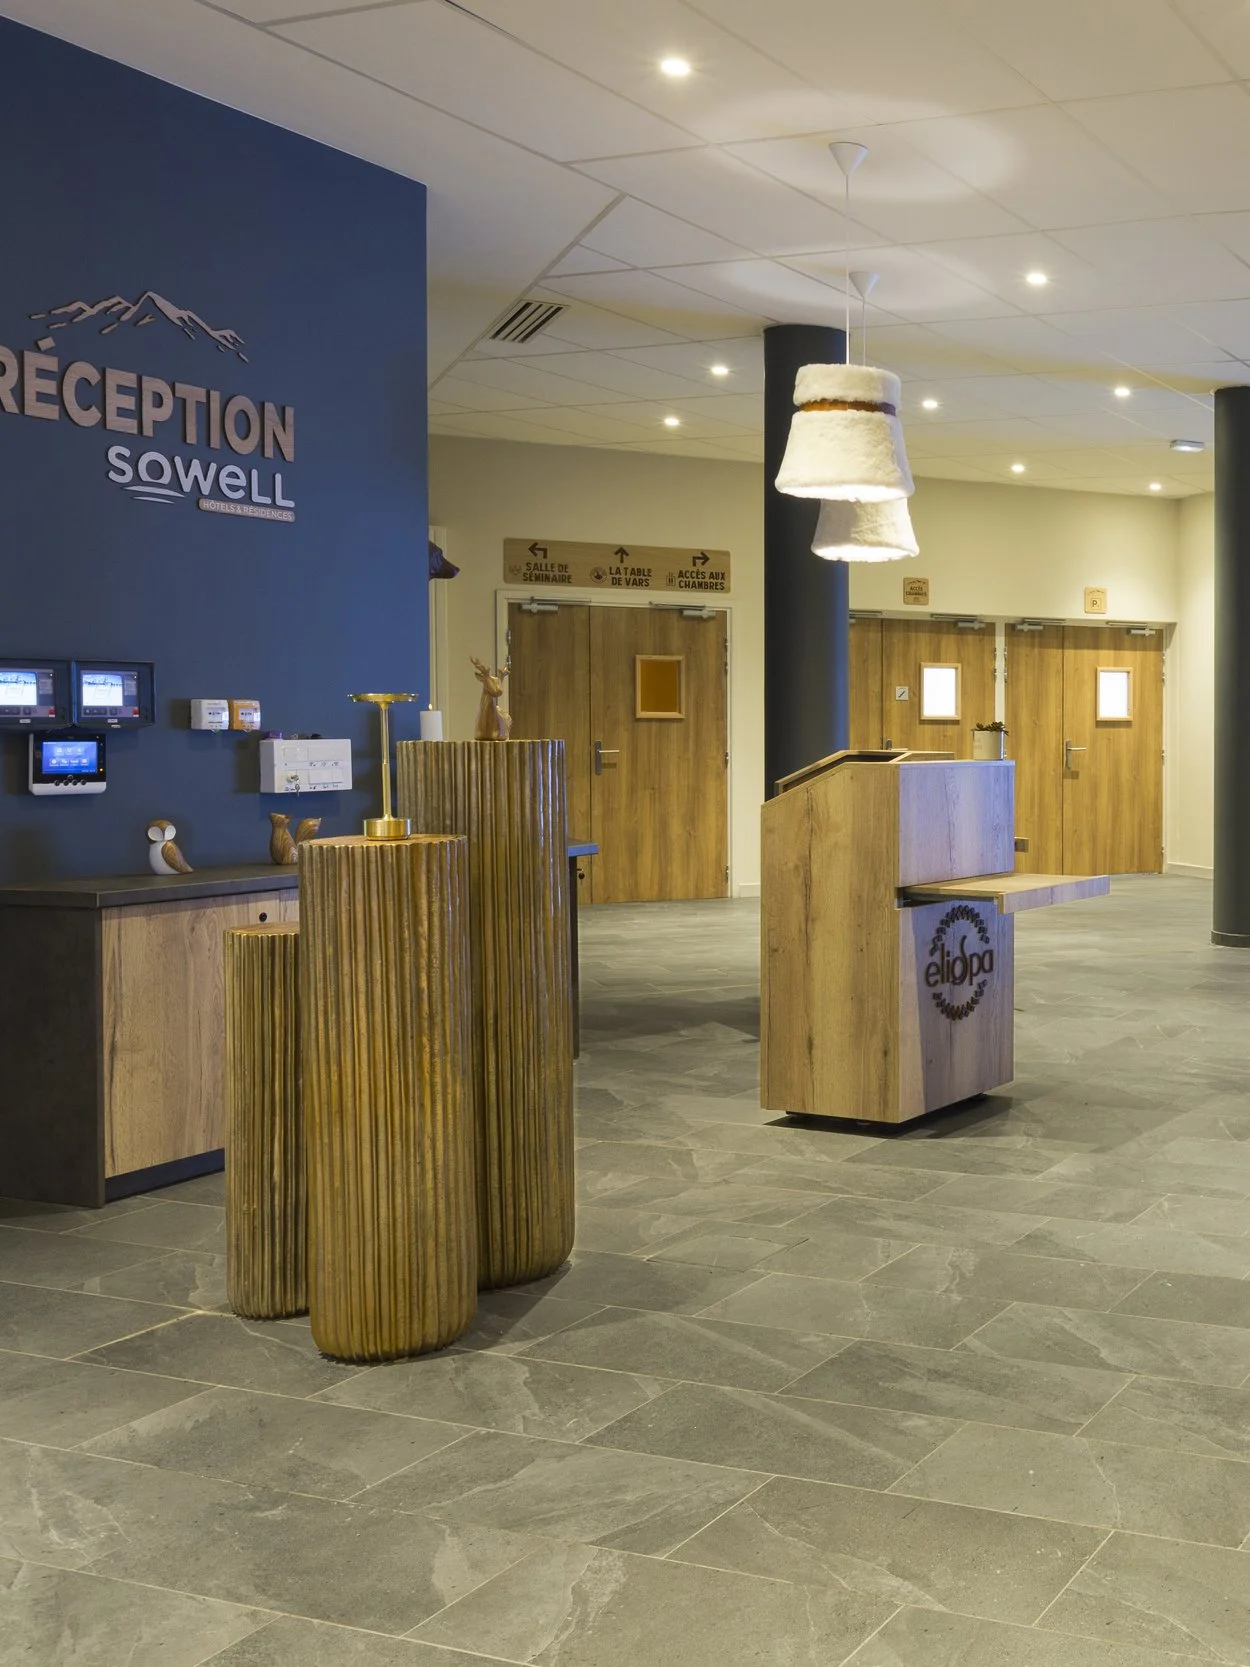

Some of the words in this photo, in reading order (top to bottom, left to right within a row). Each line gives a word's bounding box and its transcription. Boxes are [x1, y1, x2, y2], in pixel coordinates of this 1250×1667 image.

[203, 500, 235, 513] HÔTELS
[236, 506, 242, 514] &
[243, 505, 293, 520] RÉSIDENCES
[525, 562, 556, 573] SALLE
[557, 564, 569, 573] DE
[608, 566, 622, 576] LA
[623, 567, 652, 577] TABLE
[522, 571, 573, 584] SÉMINAIRE
[677, 569, 706, 580] ACCÈS
[708, 571, 726, 581] AUX
[611, 577, 623, 586] DE
[625, 577, 650, 587] VARS
[678, 580, 726, 591] CHAMBRES
[925, 935, 994, 987] eliopa
